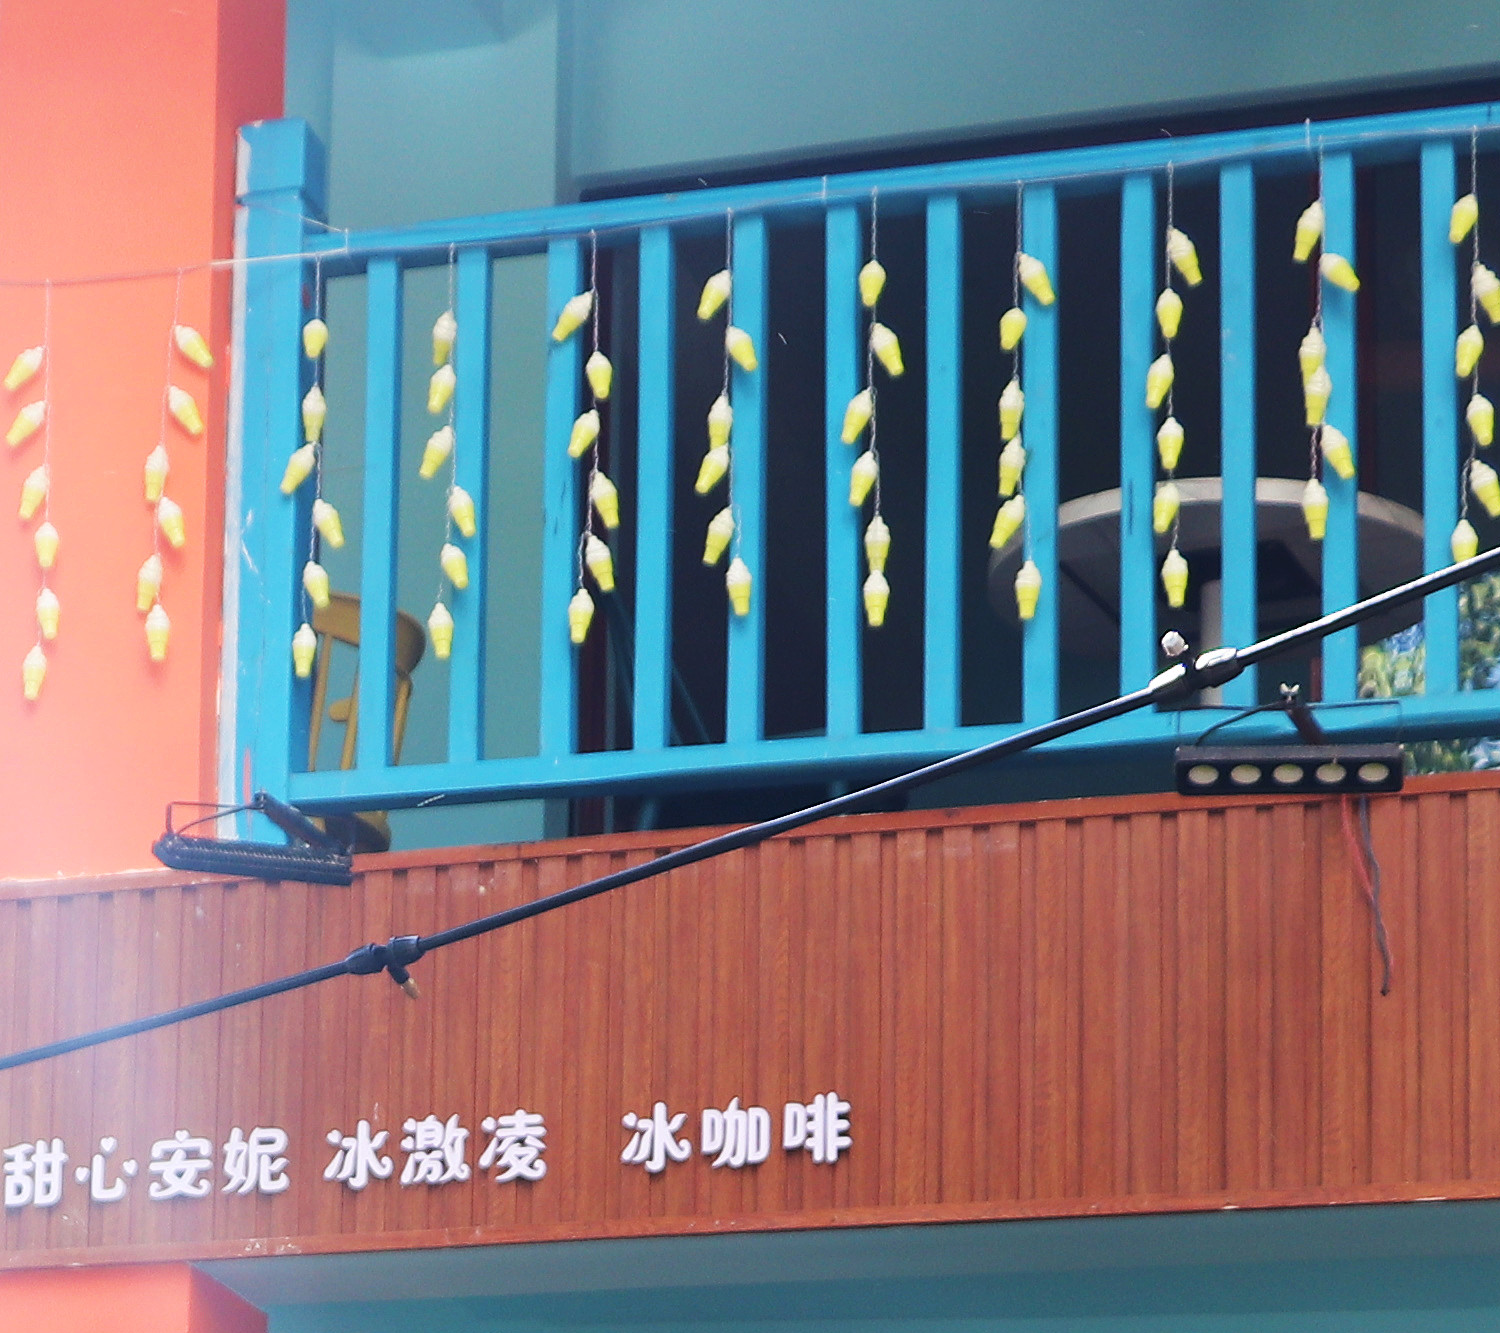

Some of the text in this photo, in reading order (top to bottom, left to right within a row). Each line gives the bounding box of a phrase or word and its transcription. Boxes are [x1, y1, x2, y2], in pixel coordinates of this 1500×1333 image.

[2, 1092, 853, 1208] 甜心安妮 冰激凌 冰咖啡
